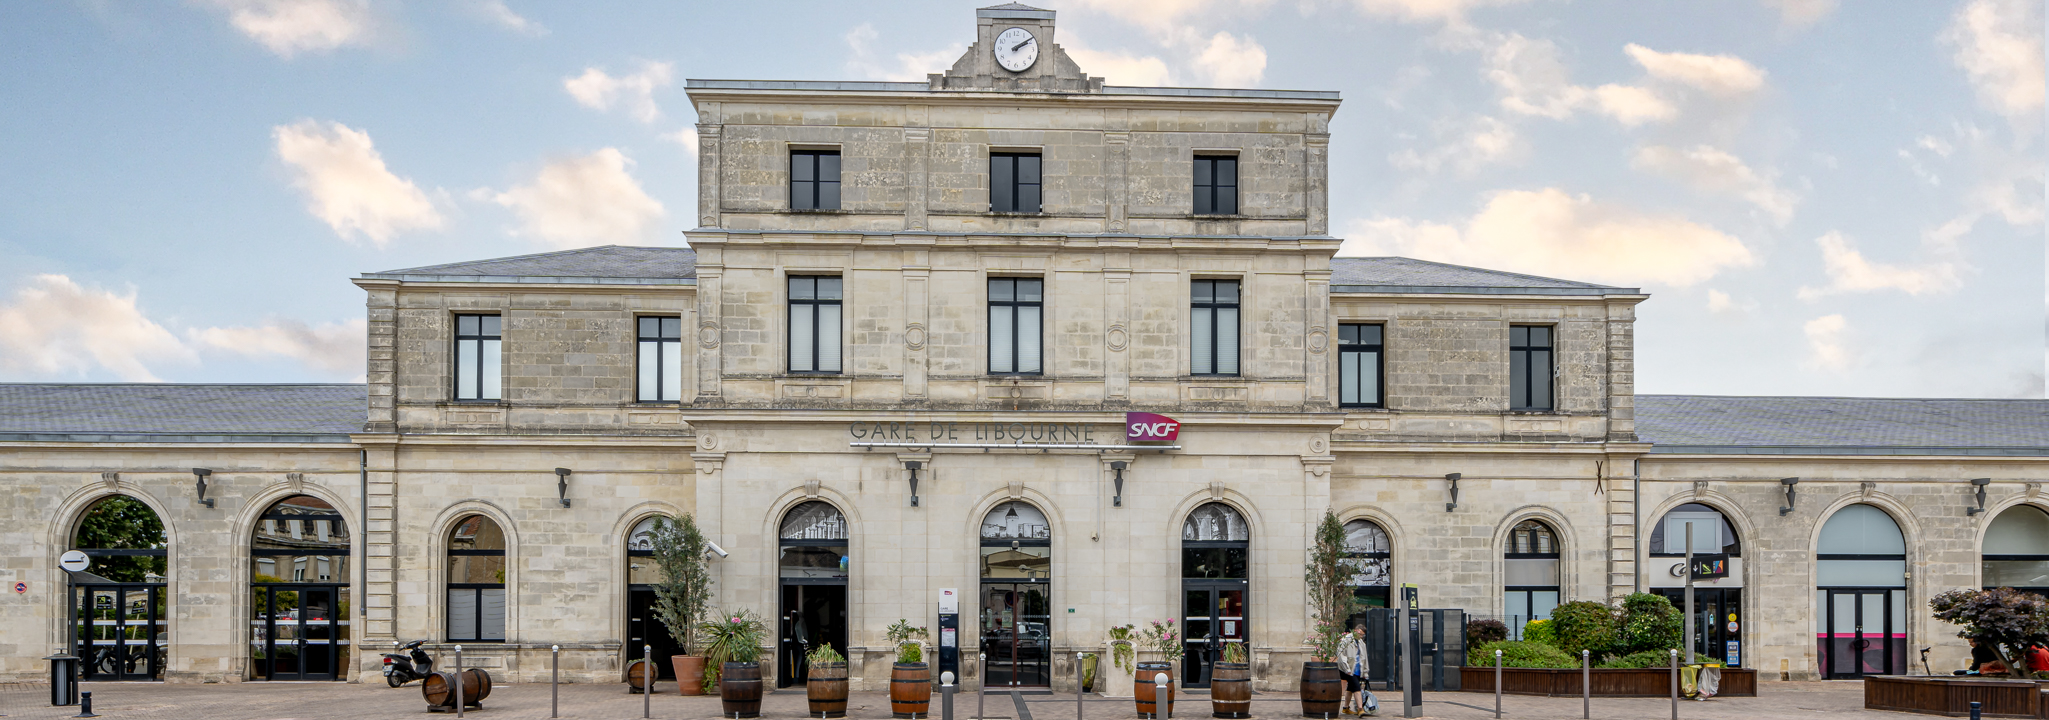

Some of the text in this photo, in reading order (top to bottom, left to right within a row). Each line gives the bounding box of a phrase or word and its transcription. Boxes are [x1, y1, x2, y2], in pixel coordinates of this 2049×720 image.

[850, 421, 1094, 441] GARE DE LIBOURNE
[1128, 423, 1178, 437] SNCF
